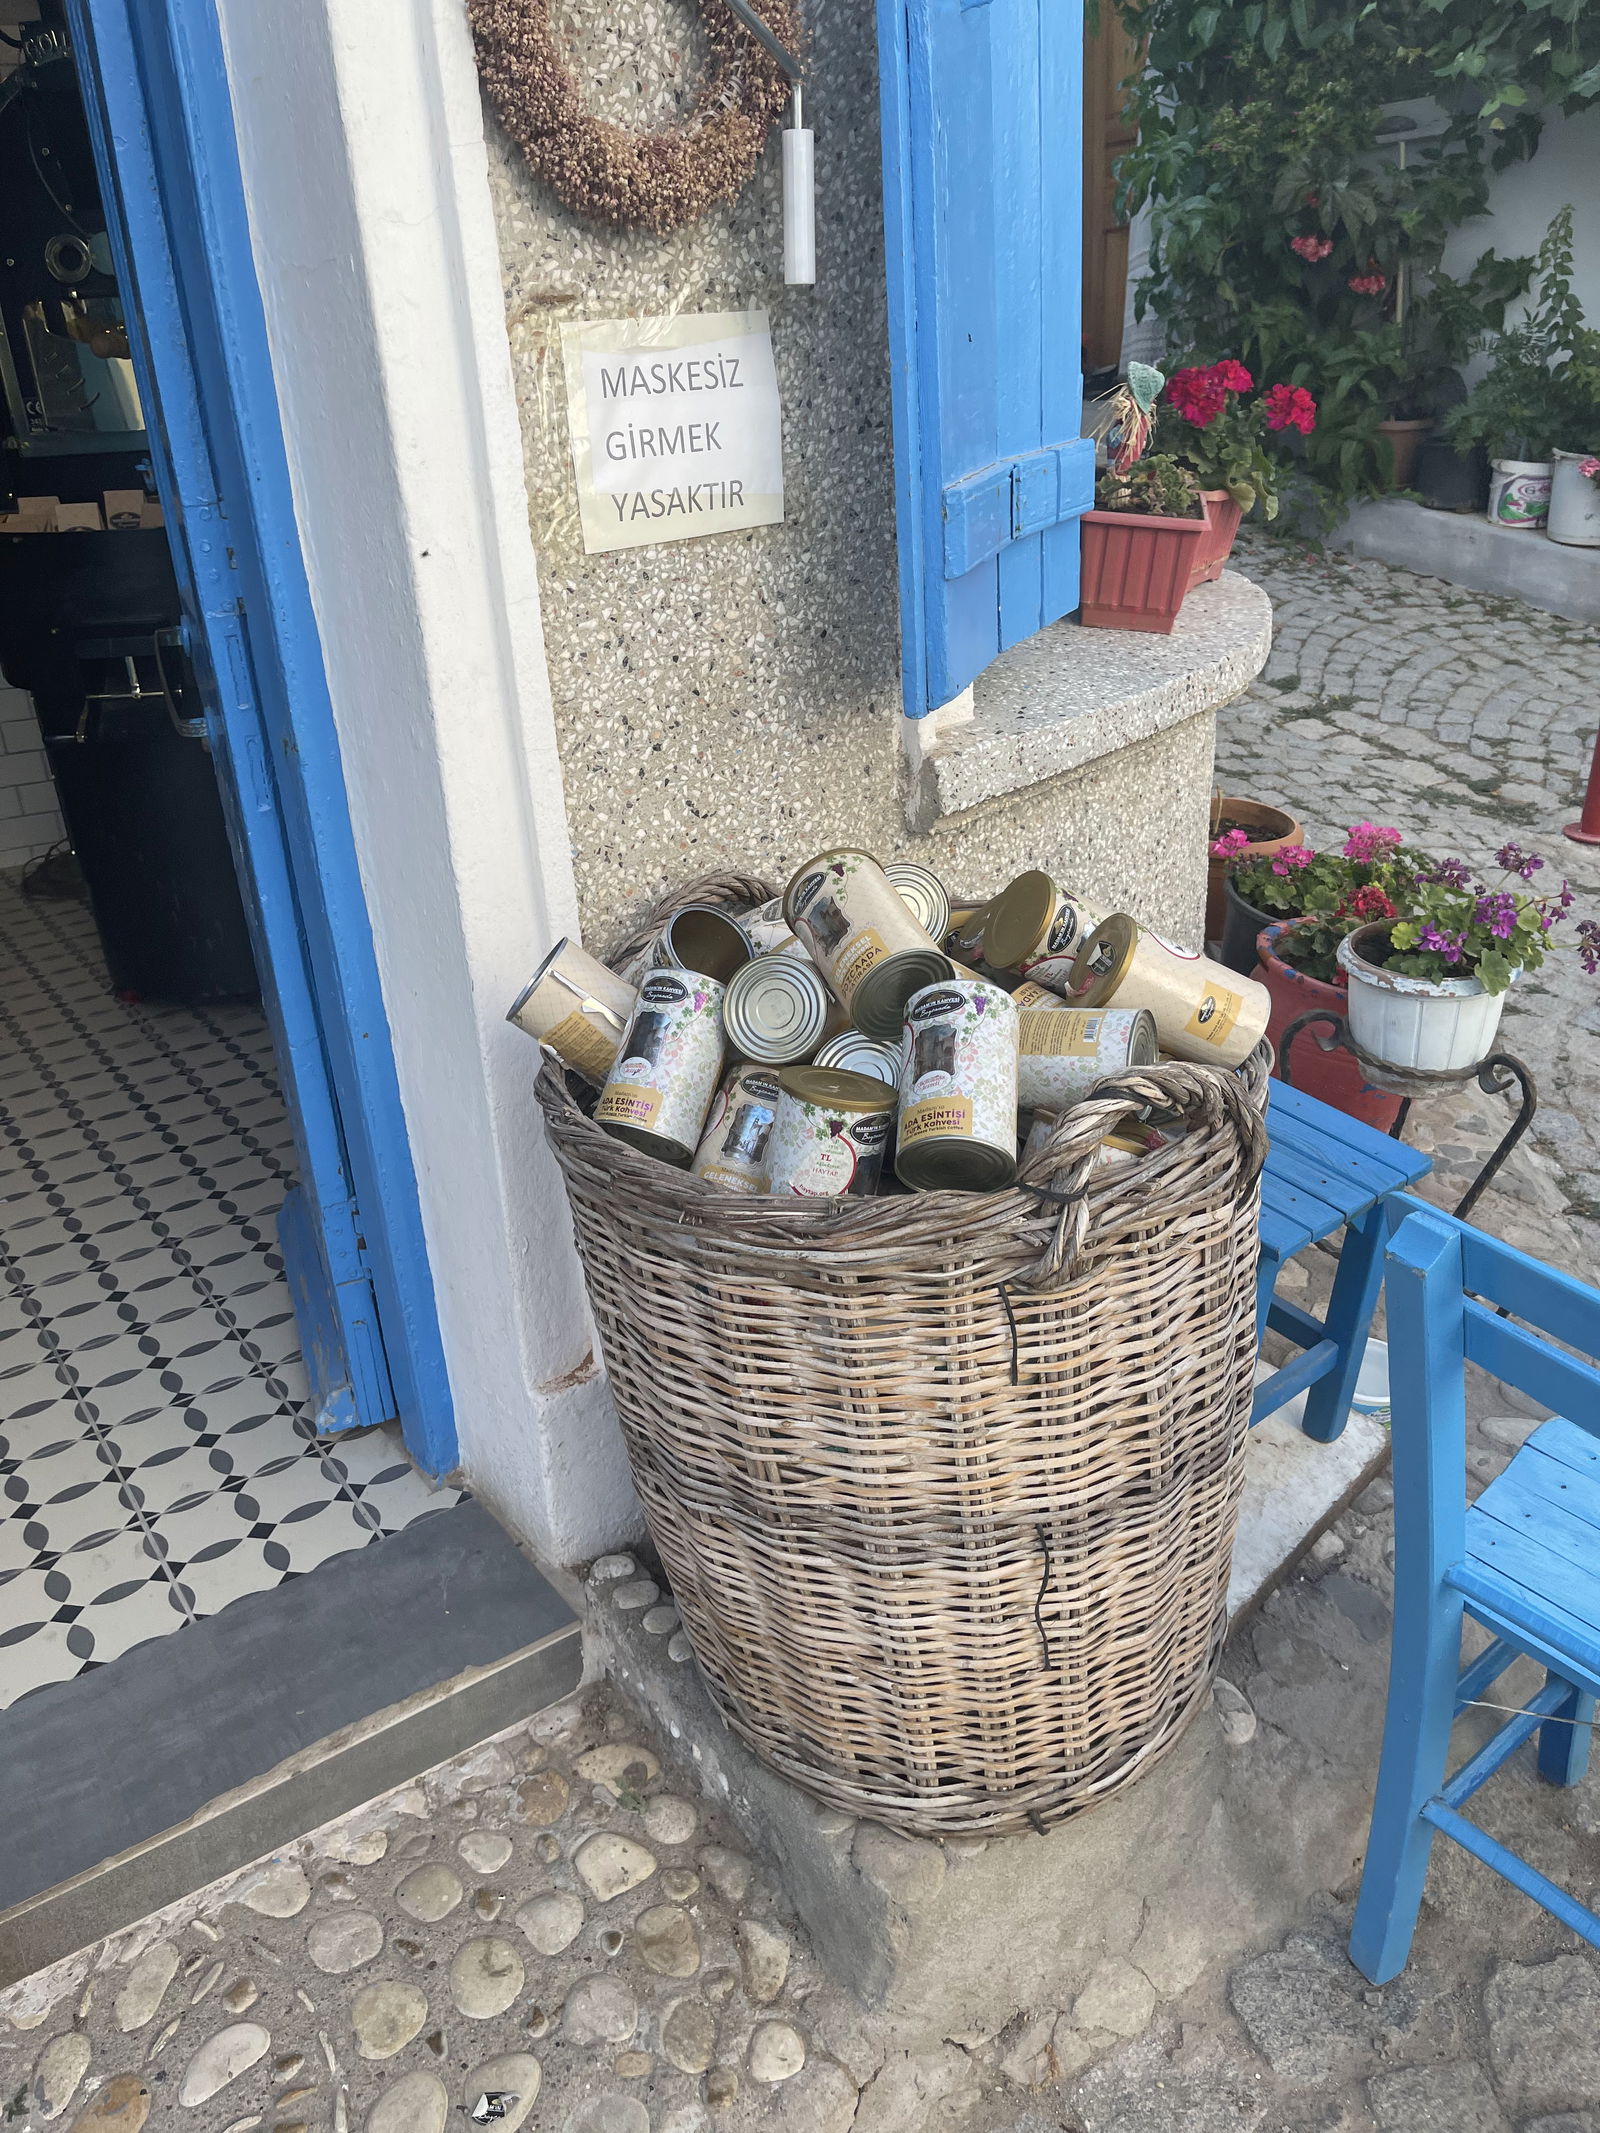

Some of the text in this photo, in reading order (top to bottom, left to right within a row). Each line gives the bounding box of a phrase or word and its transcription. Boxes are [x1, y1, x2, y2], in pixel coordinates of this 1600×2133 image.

[600, 353, 744, 398] MASKESİZ
[606, 421, 722, 461] GİRMEK
[611, 479, 744, 522] YASAKTIR
[615, 1096, 654, 1112] ESİNTİSİ
[615, 1106, 646, 1117] Kahvesi
[904, 1109, 966, 1131] ADA ESİNTİSİ
[906, 1123, 922, 1136] Türk
[924, 1118, 960, 1128] Kahvesi
[820, 1153, 832, 1162] TL
[704, 1171, 759, 1192] GELENEKSEL
[812, 1167, 839, 1177] HAYTAP
